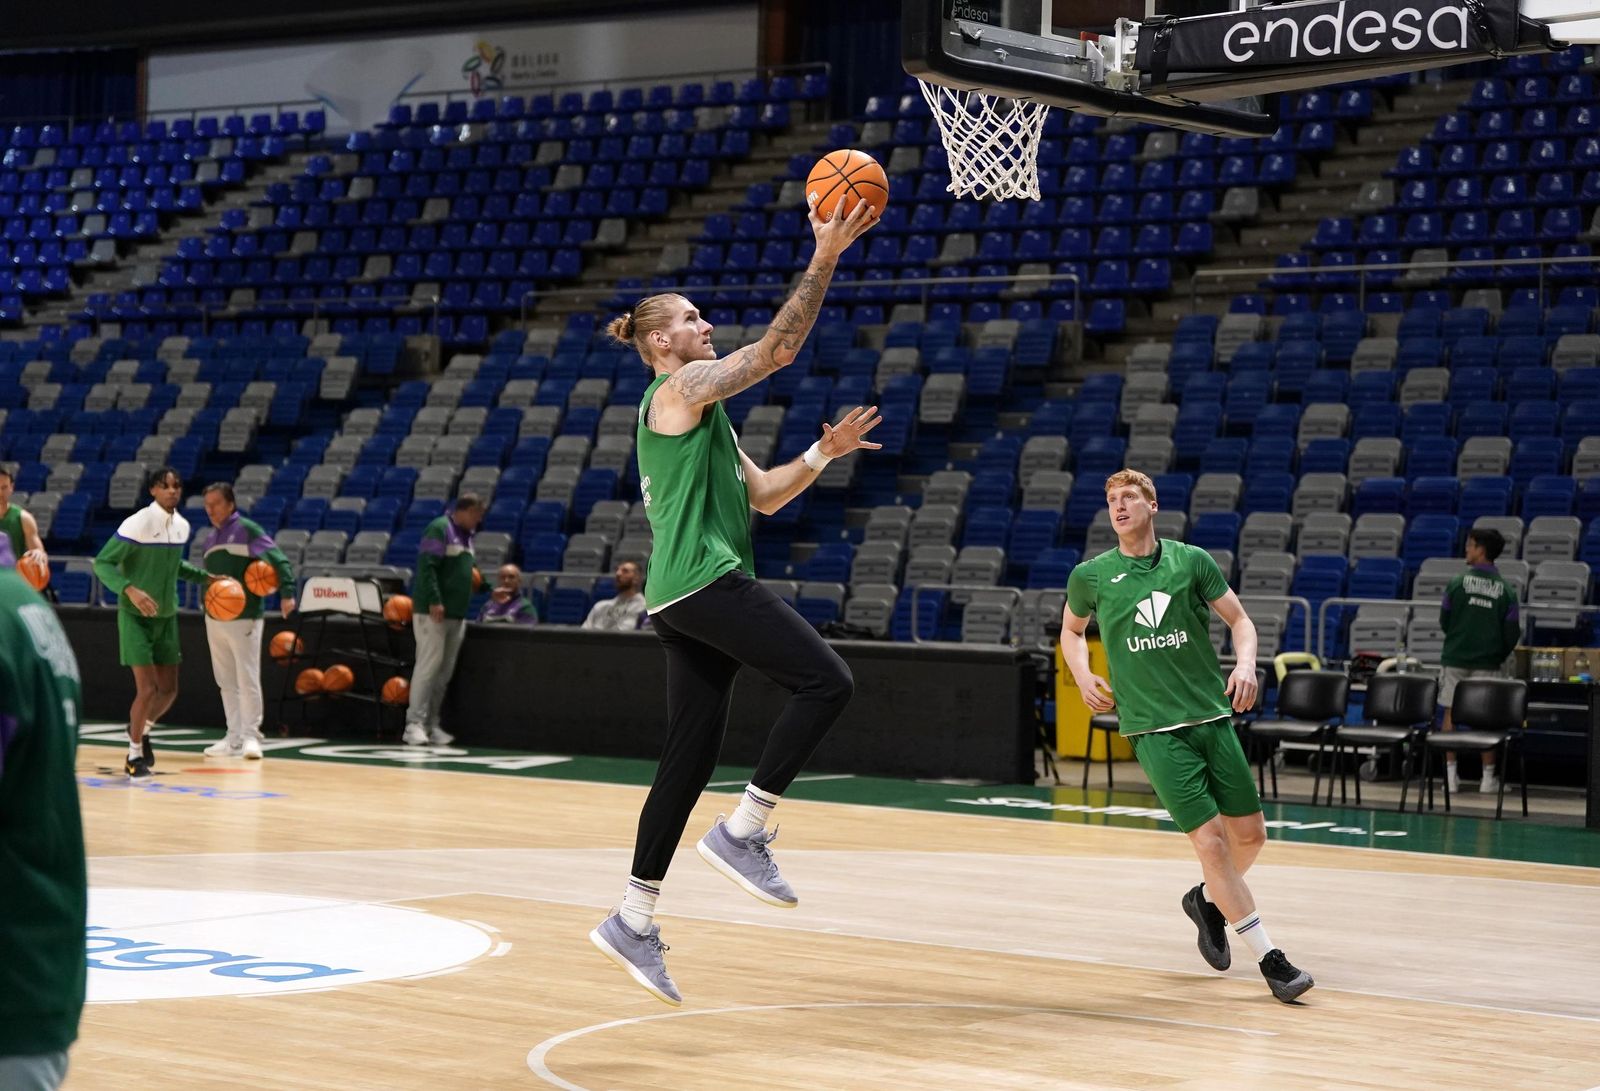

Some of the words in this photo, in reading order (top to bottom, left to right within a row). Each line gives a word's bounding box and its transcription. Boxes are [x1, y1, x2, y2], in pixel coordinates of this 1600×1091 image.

[952, 5, 988, 22] endesa
[1223, 1, 1468, 62] endesa
[313, 587, 348, 598] Wilson
[1127, 629, 1188, 653] Unicaja
